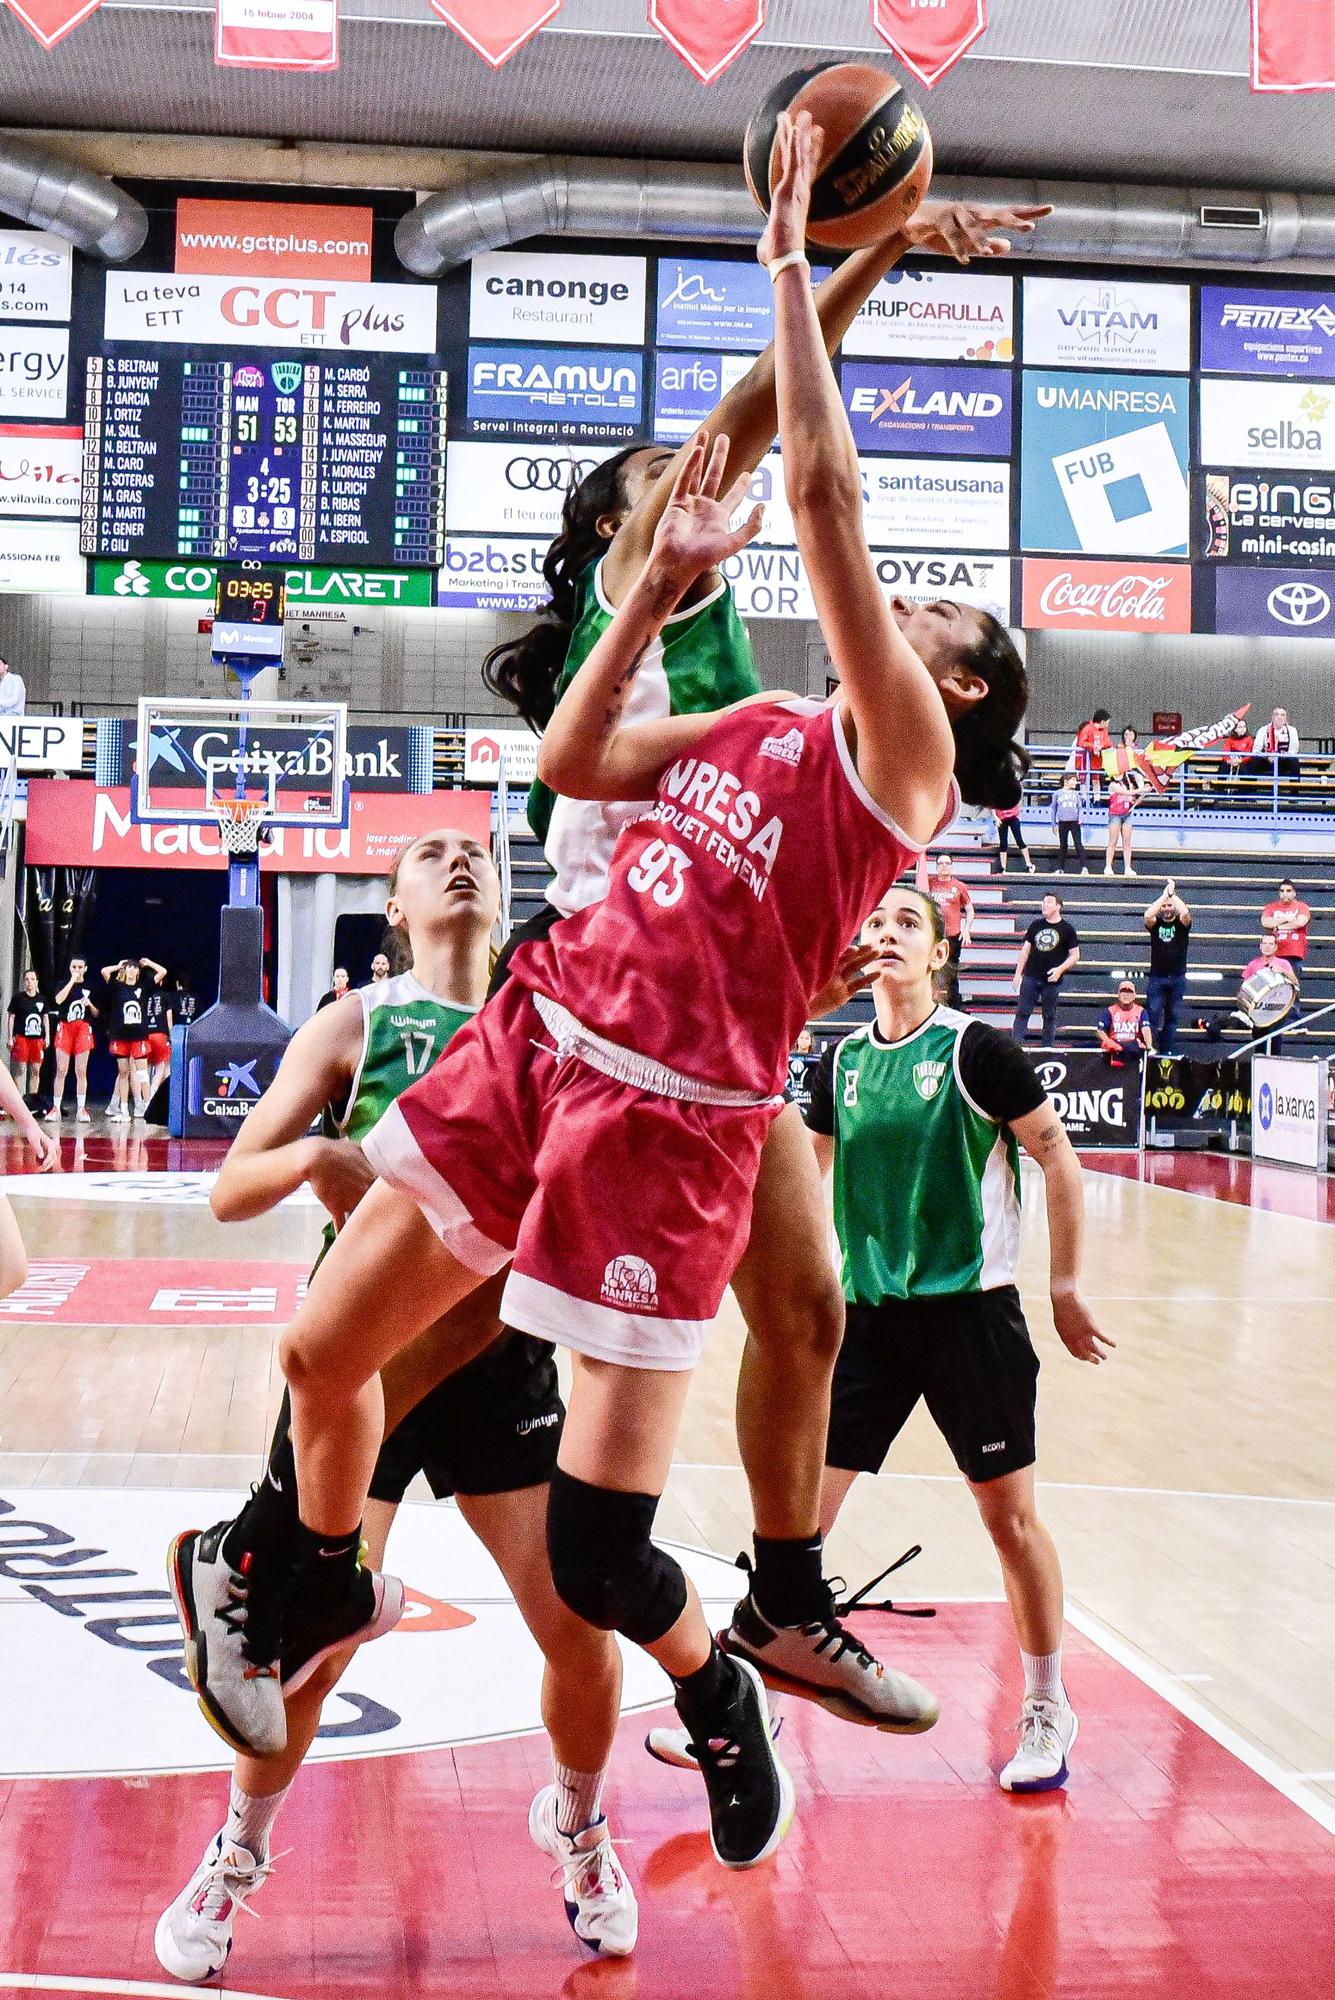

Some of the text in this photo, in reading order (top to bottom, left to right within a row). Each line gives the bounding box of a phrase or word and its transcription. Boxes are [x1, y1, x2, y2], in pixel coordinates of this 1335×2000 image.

[290, 11, 314, 20] 2004
[180, 232, 369, 258] www.gctplus.com
[123, 284, 201, 303] La teva
[485, 276, 629, 306] canonge
[146, 309, 184, 327] ETT
[220, 285, 405, 345] GCT plus
[512, 307, 594, 325] Restaurant
[1057, 309, 1158, 330] VITAM
[1220, 304, 1314, 331] PENTEX
[300, 333, 328, 345] ETT
[91, 359, 159, 374] 5 S. BELTRAN
[309, 366, 370, 382] 5 M. CARBÓ
[91, 375, 159, 390] 7 B. JUNYENT
[473, 362, 636, 392] FRAMUN
[661, 361, 718, 392] arfe
[11, 387, 63, 399] SERVICE
[91, 391, 150, 406] 8 J. GARCIA
[309, 383, 447, 403] 7 M. SERRA 13
[850, 376, 1003, 424] EXLAND
[1037, 387, 1176, 414] UMANRESA
[236, 395, 296, 414] MAN TOR
[308, 399, 381, 415] 8 M. FERREIRO
[88, 408, 142, 422] 10 J. ORTIZ
[306, 416, 370, 430] 10 K. MARTIN
[89, 423, 141, 438] 11 M. SALL
[238, 414, 297, 443] 51 53
[513, 421, 558, 435] Integral
[562, 423, 576, 434] de
[580, 424, 634, 436] Retolació
[1247, 420, 1322, 451] selba
[86, 440, 157, 455] 12 N. BELTRAN
[307, 432, 387, 447] 11 M. MASSEGUR
[86, 456, 144, 471] 14 M. CARO
[305, 448, 383, 463] 14 J. JUVANTENY
[260, 457, 270, 476] 4
[305, 464, 375, 479] 15 T. MORALES
[1064, 452, 1115, 485] FUB
[86, 473, 154, 488] 15 J. SOTERAS
[305, 480, 367, 495] 17 R. ULRICH
[878, 474, 1004, 494] santasusana
[85, 489, 142, 503] 21 M. GRAS
[247, 476, 291, 504] 3:25
[1229, 483, 1335, 515] BING
[84, 505, 145, 520] 23 M. MARTI
[302, 496, 360, 511] 25 B. RIBAS
[241, 508, 288, 526] 3 3
[303, 512, 361, 527] 77 M. IBERN
[503, 508, 536, 520] El teu
[1231, 513, 1254, 526] La
[82, 522, 145, 536] 24 C. GENER
[301, 528, 370, 544] 00 A. ESPIGOL
[82, 538, 94, 551] 93
[101, 538, 109, 552] P.
[110, 539, 130, 552] GILI
[213, 541, 226, 557] 21
[301, 545, 313, 558] 99
[1241, 534, 1335, 556] mini-casin
[166, 568, 218, 591] CO
[449, 577, 504, 590] Marketing
[227, 580, 273, 598] 03:25
[1040, 572, 1173, 621] Coca-Cola
[302, 610, 346, 619] MANRESA
[193, 732, 402, 778] CaixaBank
[366, 833, 388, 842] laser
[627, 838, 693, 908] 93
[400, 1031, 435, 1075] 17
[843, 1069, 859, 1108] 8
[600, 1283, 659, 1306] MANRESA
